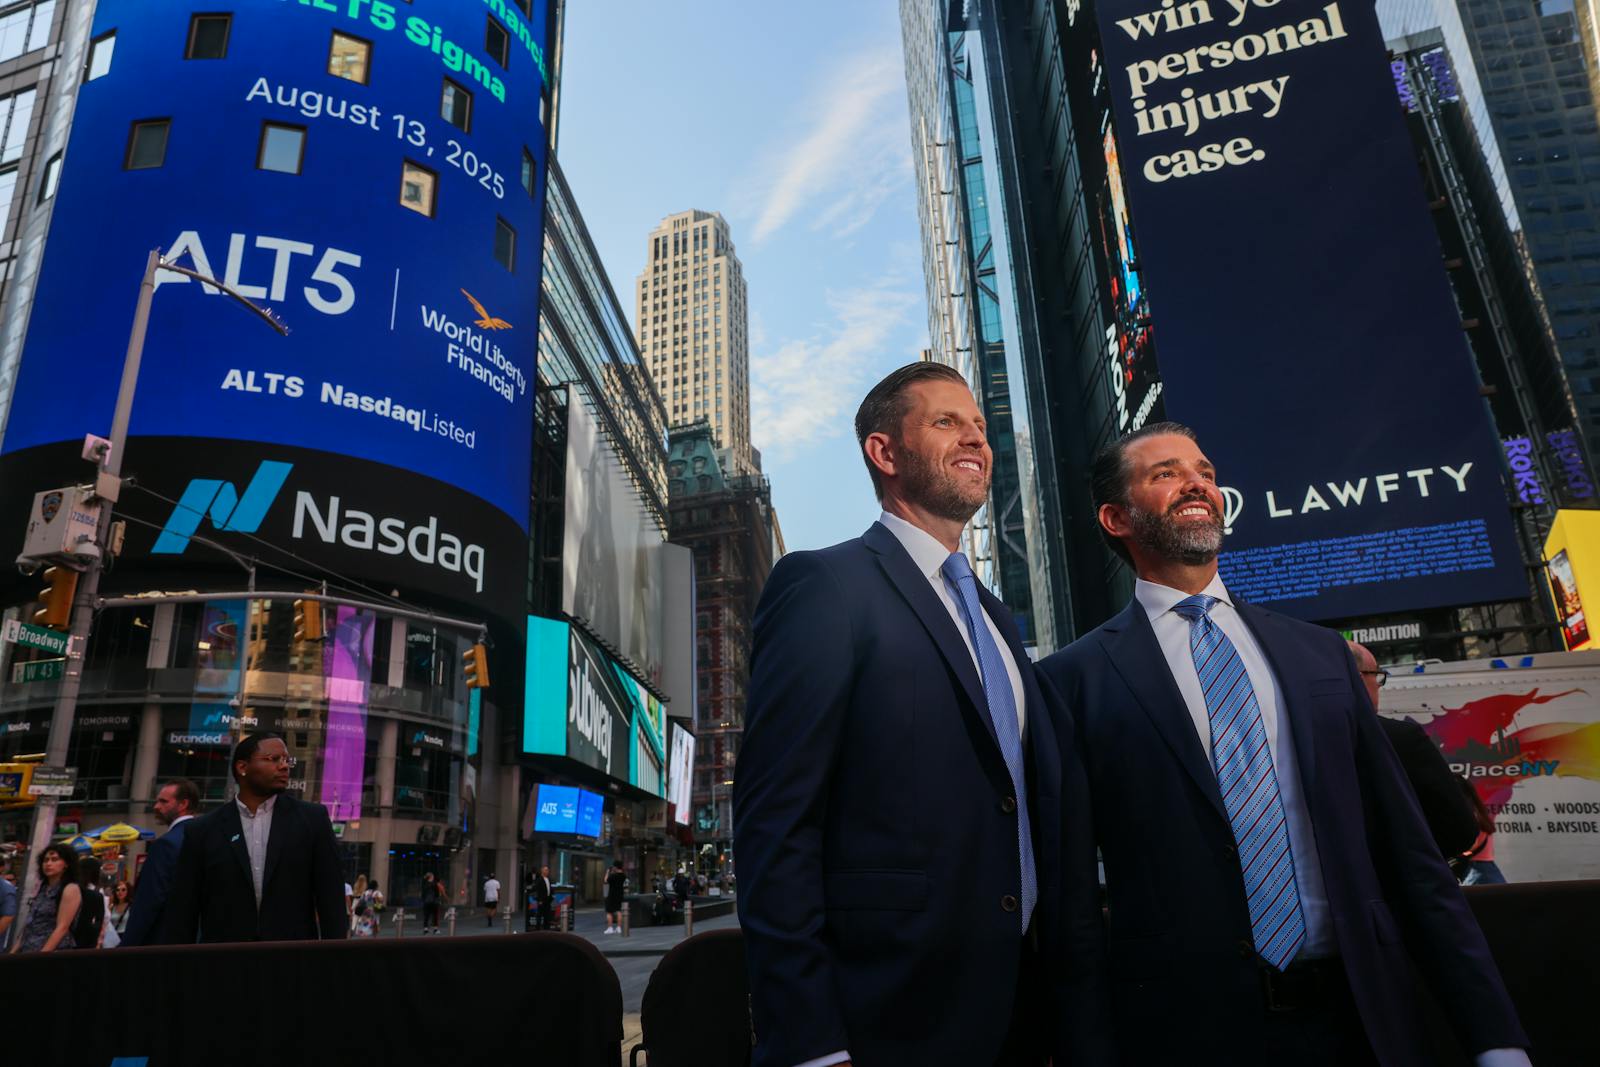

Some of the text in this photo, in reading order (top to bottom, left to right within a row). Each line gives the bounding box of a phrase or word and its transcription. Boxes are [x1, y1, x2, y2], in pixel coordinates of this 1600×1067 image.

[1115, 0, 1214, 41] win
[404, 16, 506, 104] Sigma
[1125, 2, 1348, 100] personal
[1134, 75, 1290, 137] injury
[246, 77, 506, 200] August 13, 2025
[1143, 137, 1266, 183] case.
[153, 230, 362, 315] ALT5
[421, 305, 527, 396] World Liberty
[447, 342, 515, 404] Financial
[221, 368, 304, 398] ALTS
[1266, 462, 1474, 519] LAWFTY
[1504, 436, 1545, 505] ROKU
[292, 490, 487, 594] Nasdaq
[19, 626, 65, 654] Broadway
[1352, 623, 1420, 643] TRADITION
[26, 664, 37, 681] W
[40, 662, 54, 679] 43
[79, 716, 129, 726] TOMORROW
[221, 713, 258, 727] Ndaq
[1491, 821, 1599, 833] TORIA BAYSIDE
[1553, 802, 1600, 815] WOODS
